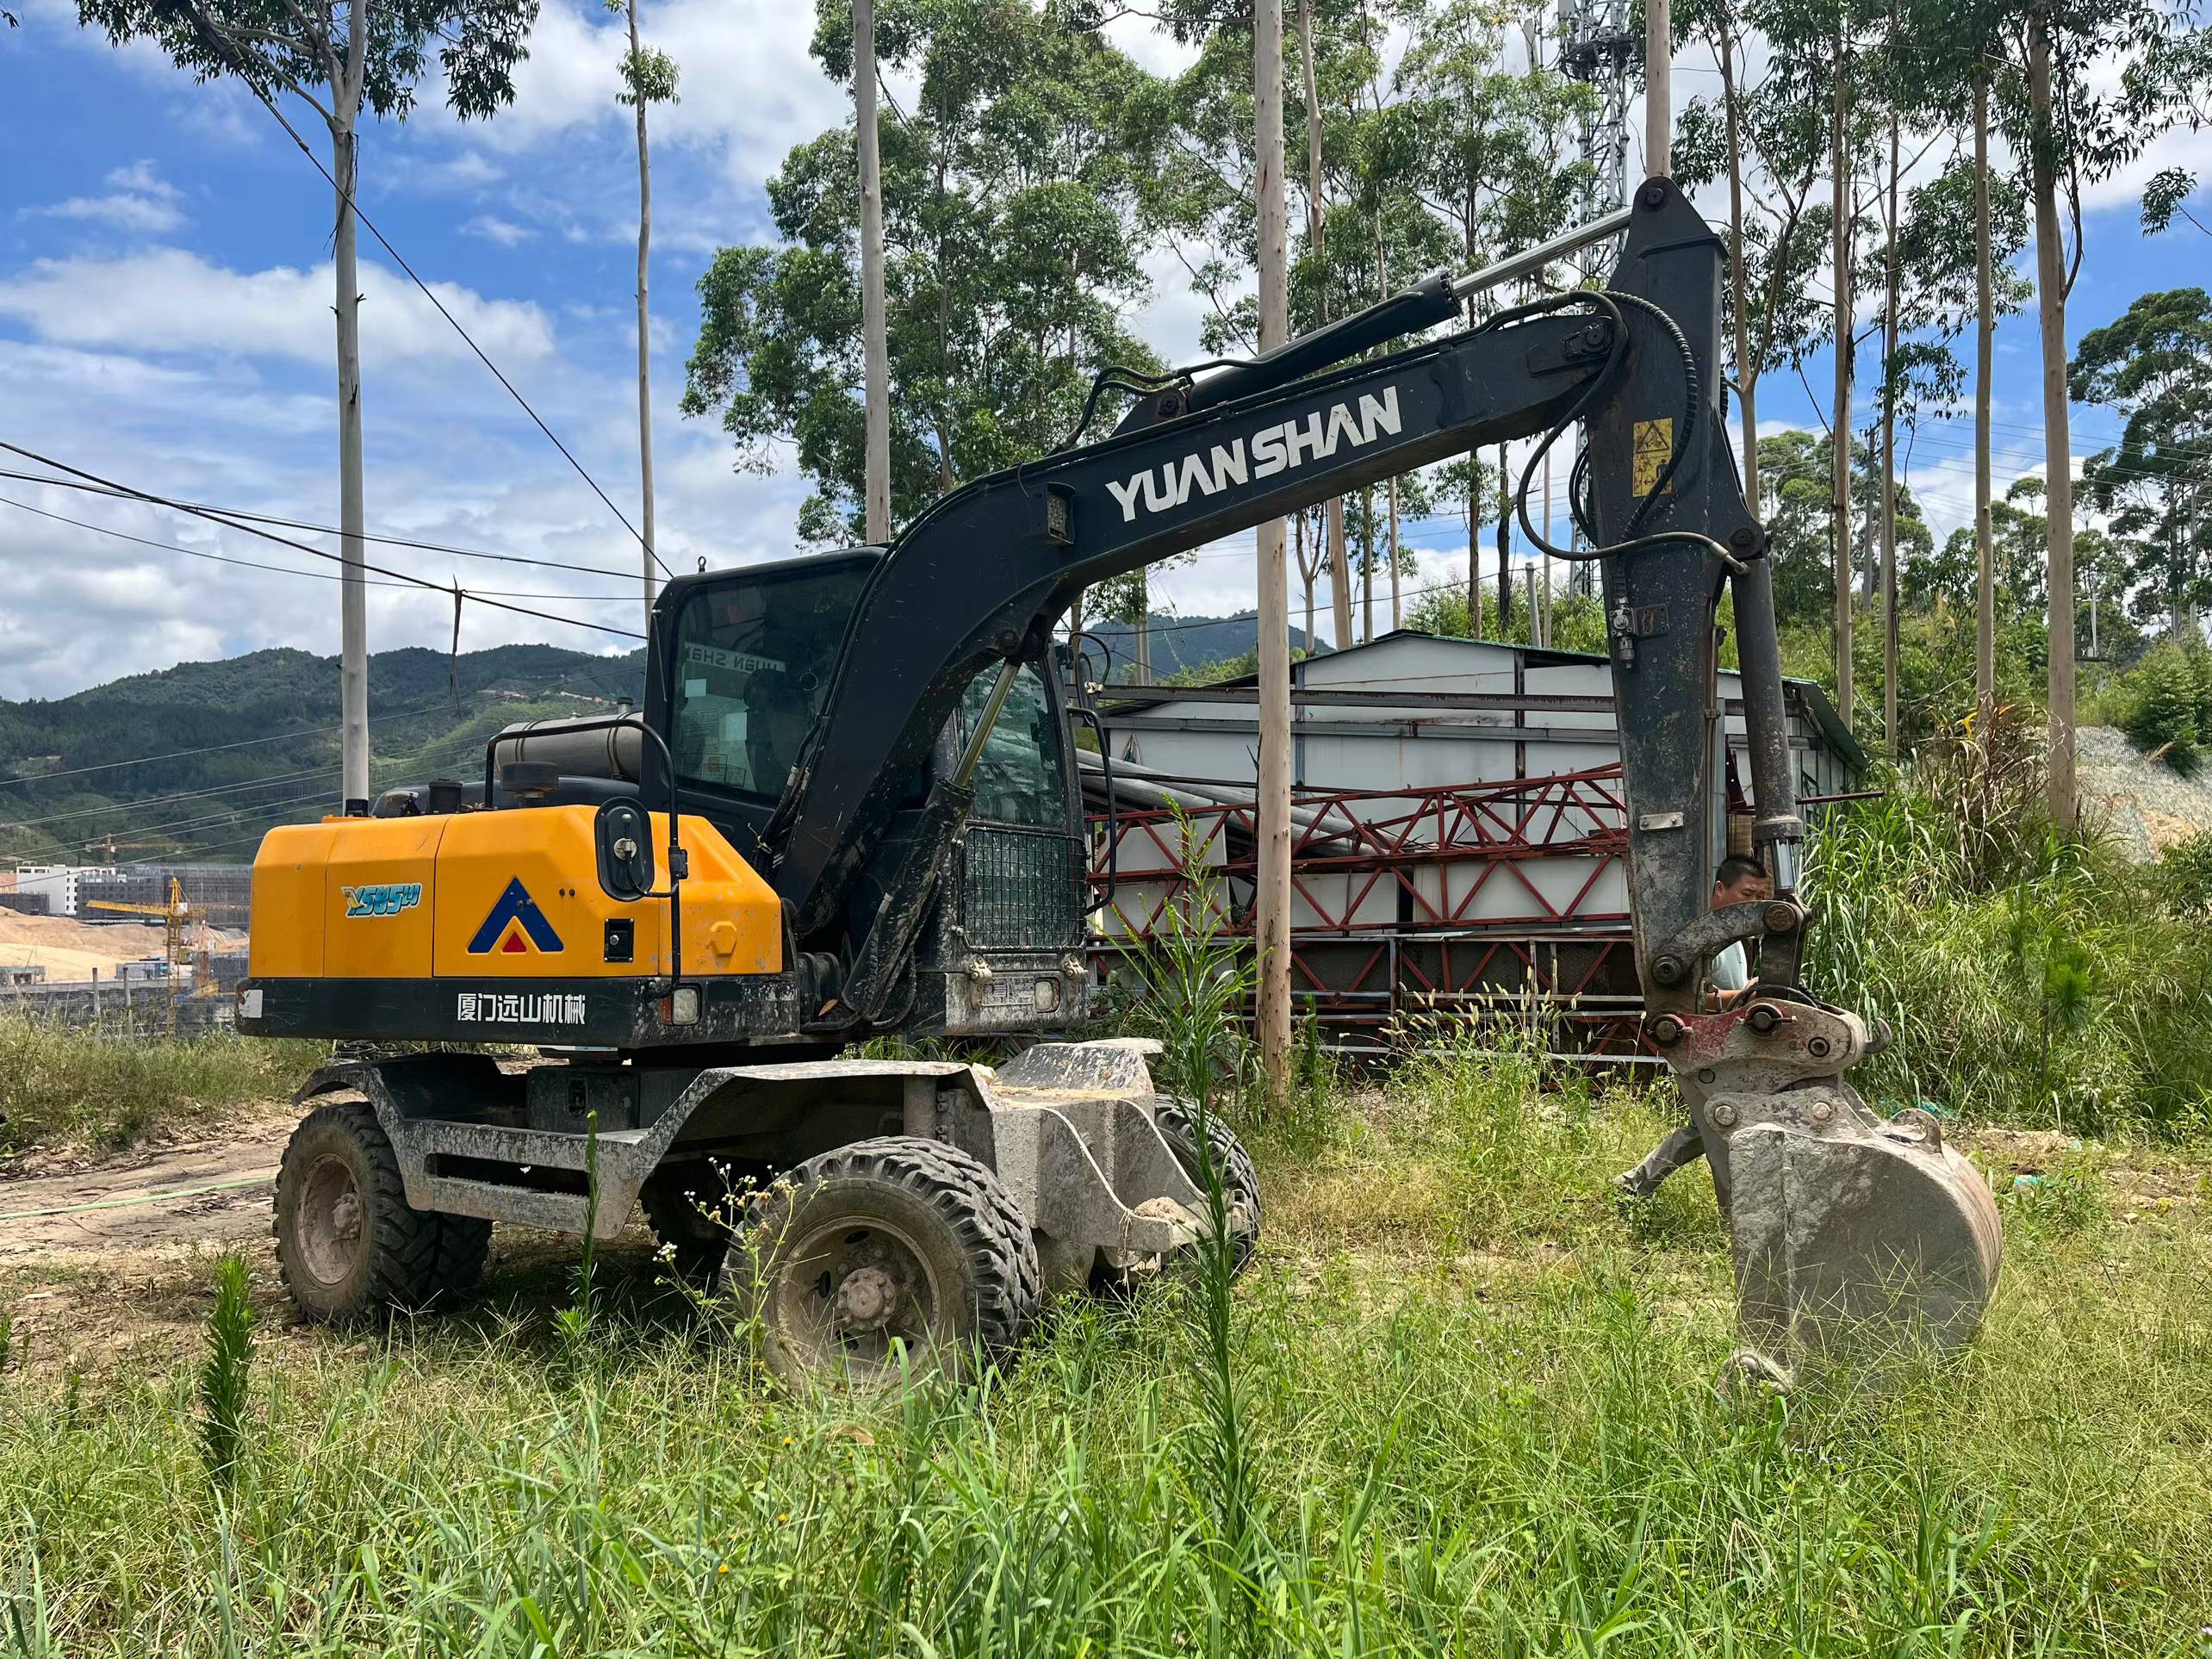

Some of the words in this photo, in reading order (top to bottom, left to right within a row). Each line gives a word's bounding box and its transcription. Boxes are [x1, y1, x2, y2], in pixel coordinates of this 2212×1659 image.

[457, 993, 586, 1024] 厦门远山机械
